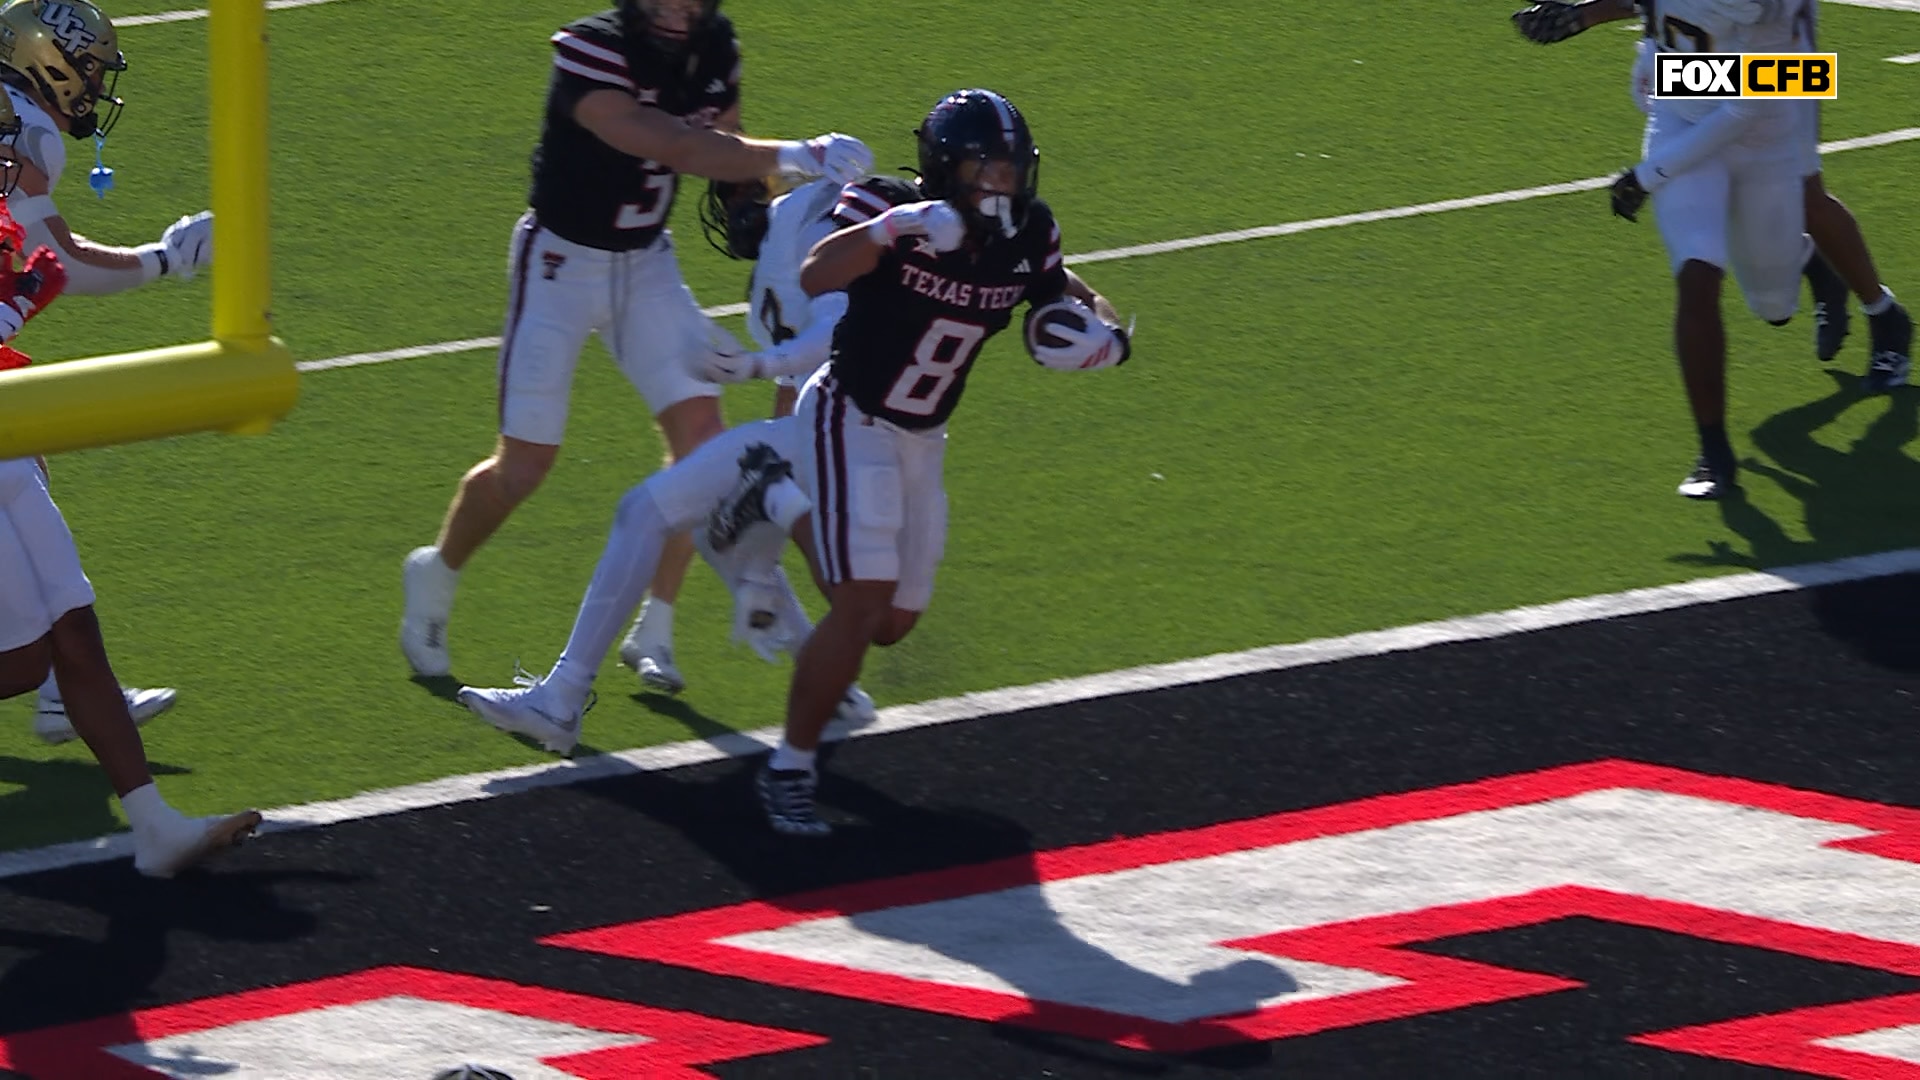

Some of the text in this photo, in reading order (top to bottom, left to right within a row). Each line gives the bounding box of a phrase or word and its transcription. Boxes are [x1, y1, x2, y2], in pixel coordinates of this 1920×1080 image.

[41, 0, 97, 54] UCF
[901, 263, 973, 307] TEXAS
[882, 316, 987, 417] 8
